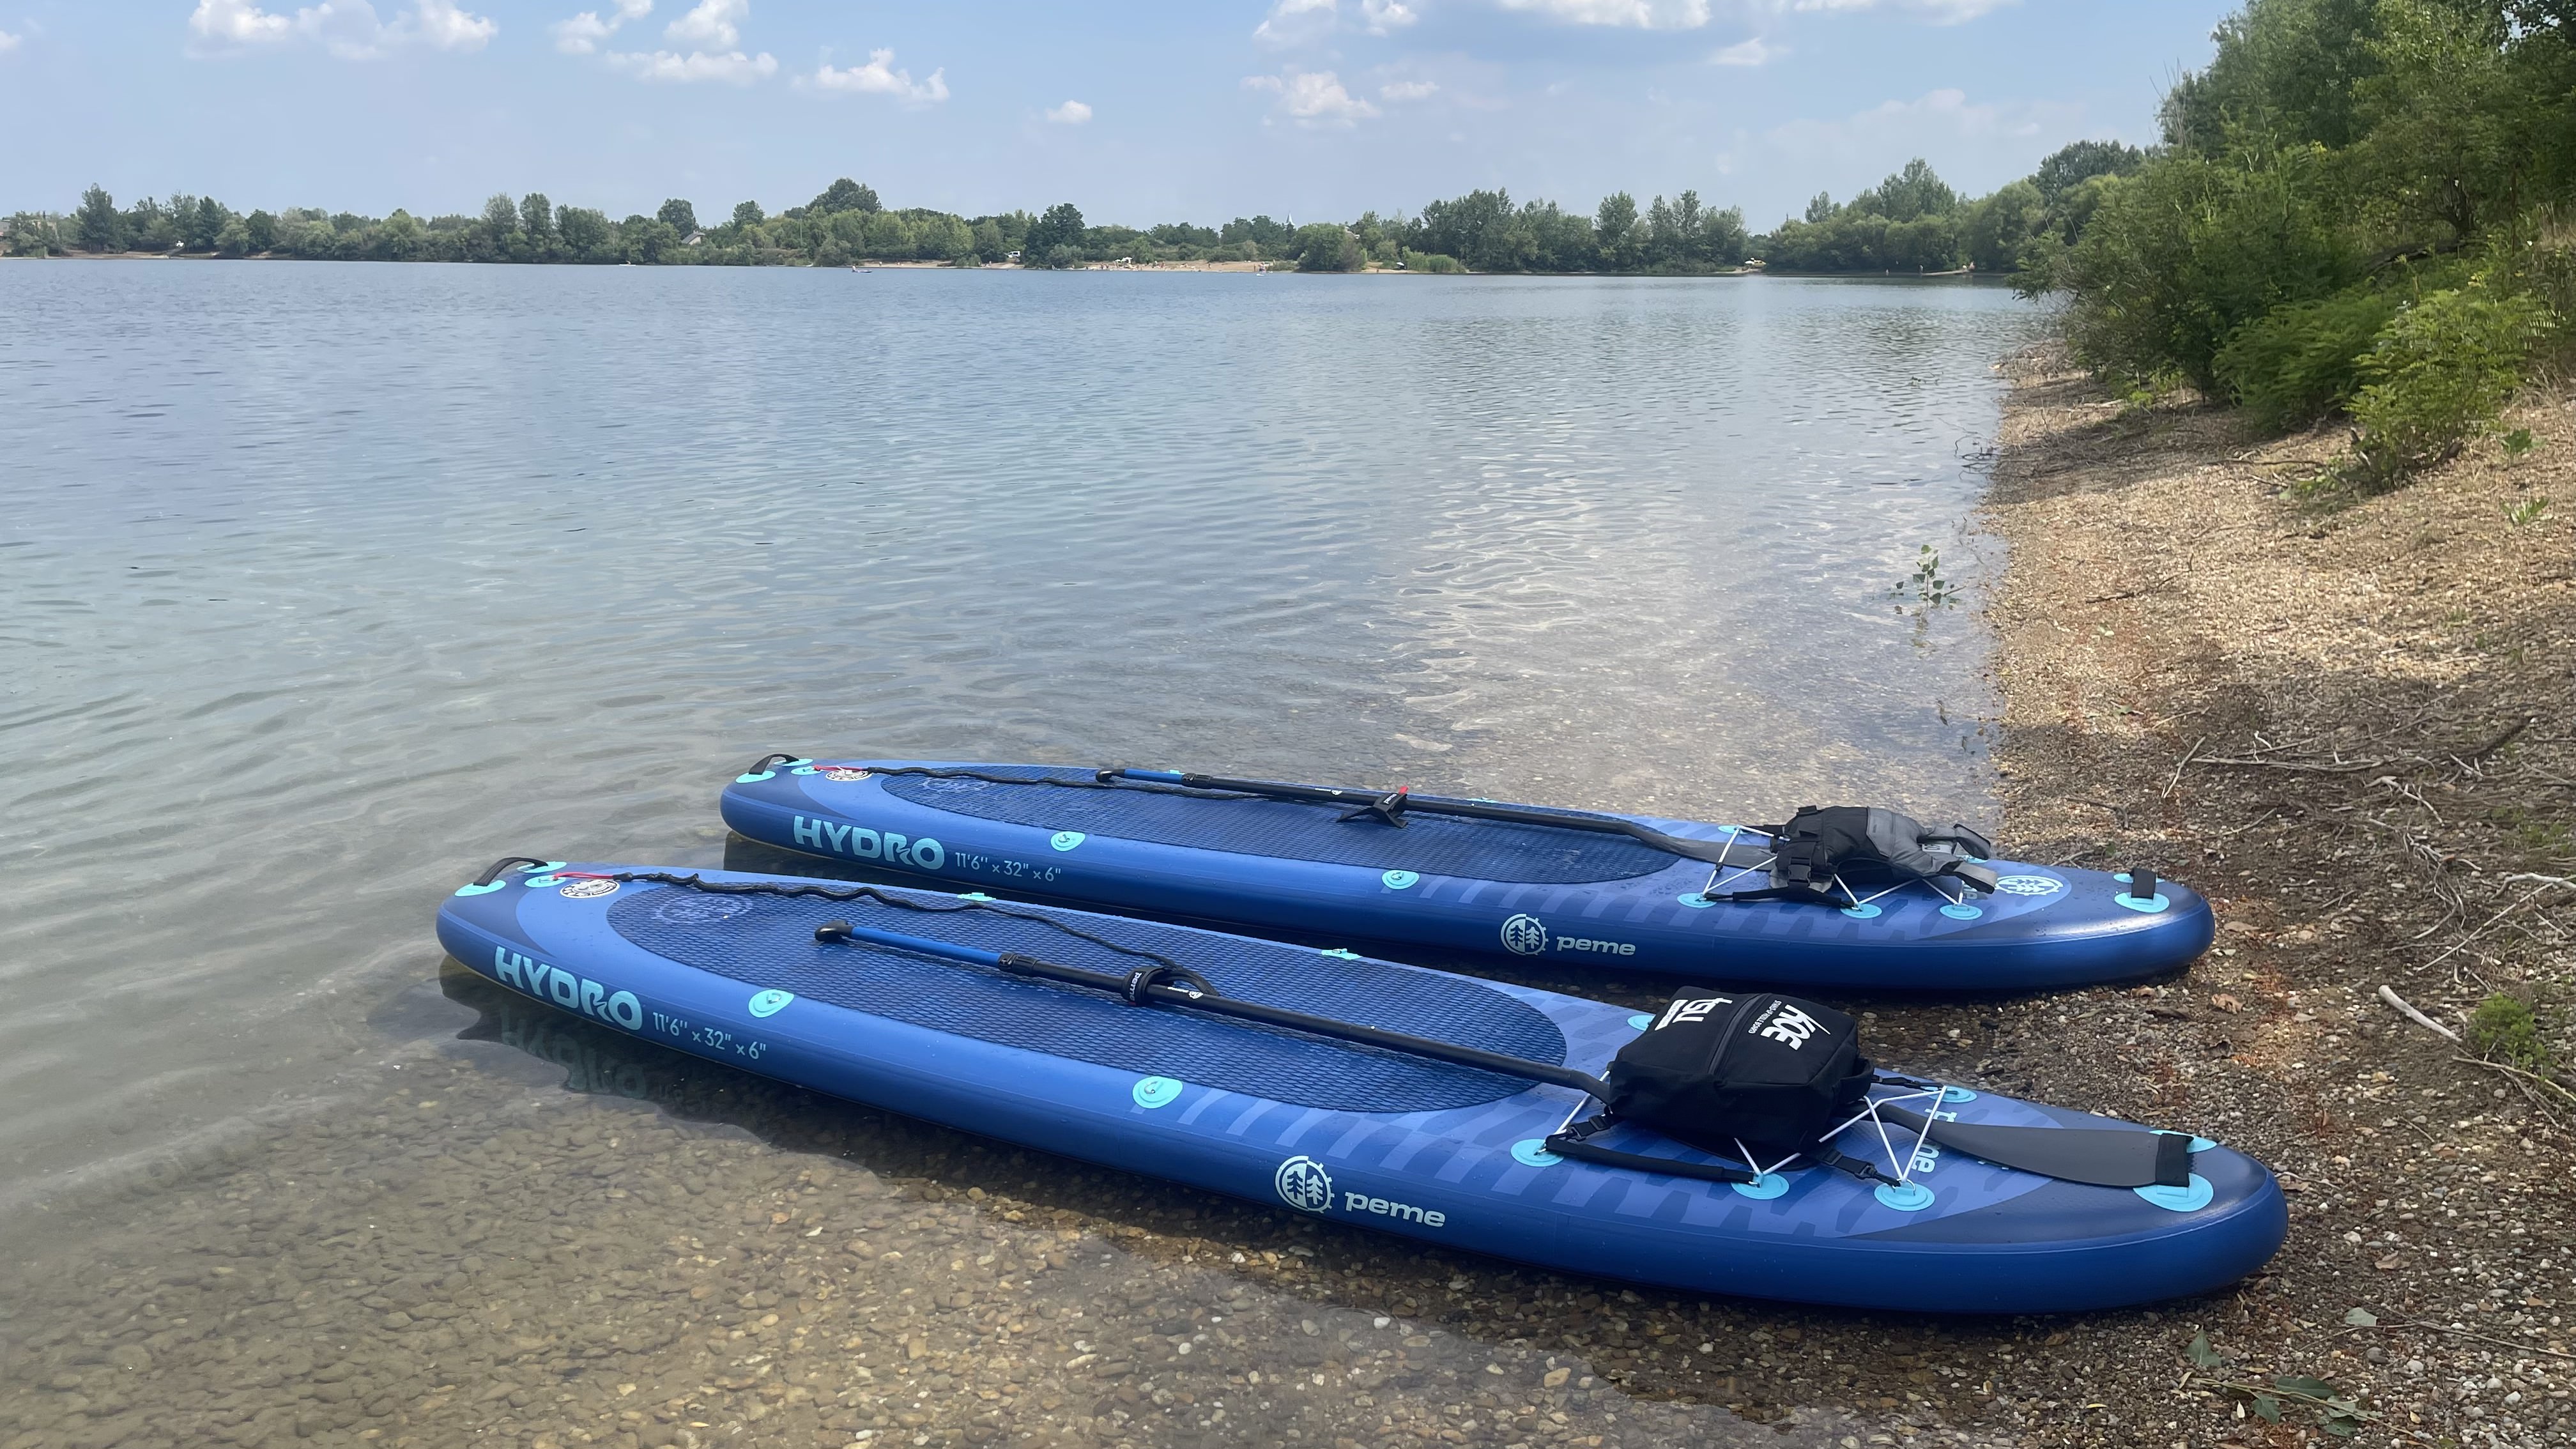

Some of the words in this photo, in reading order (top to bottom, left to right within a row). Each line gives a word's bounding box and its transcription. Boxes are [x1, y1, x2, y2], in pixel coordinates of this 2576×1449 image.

[793, 815, 945, 870] HYDRO
[1556, 936, 1636, 956] peme
[494, 946, 643, 1031] HYDRO
[1345, 1191, 1446, 1227] peme
